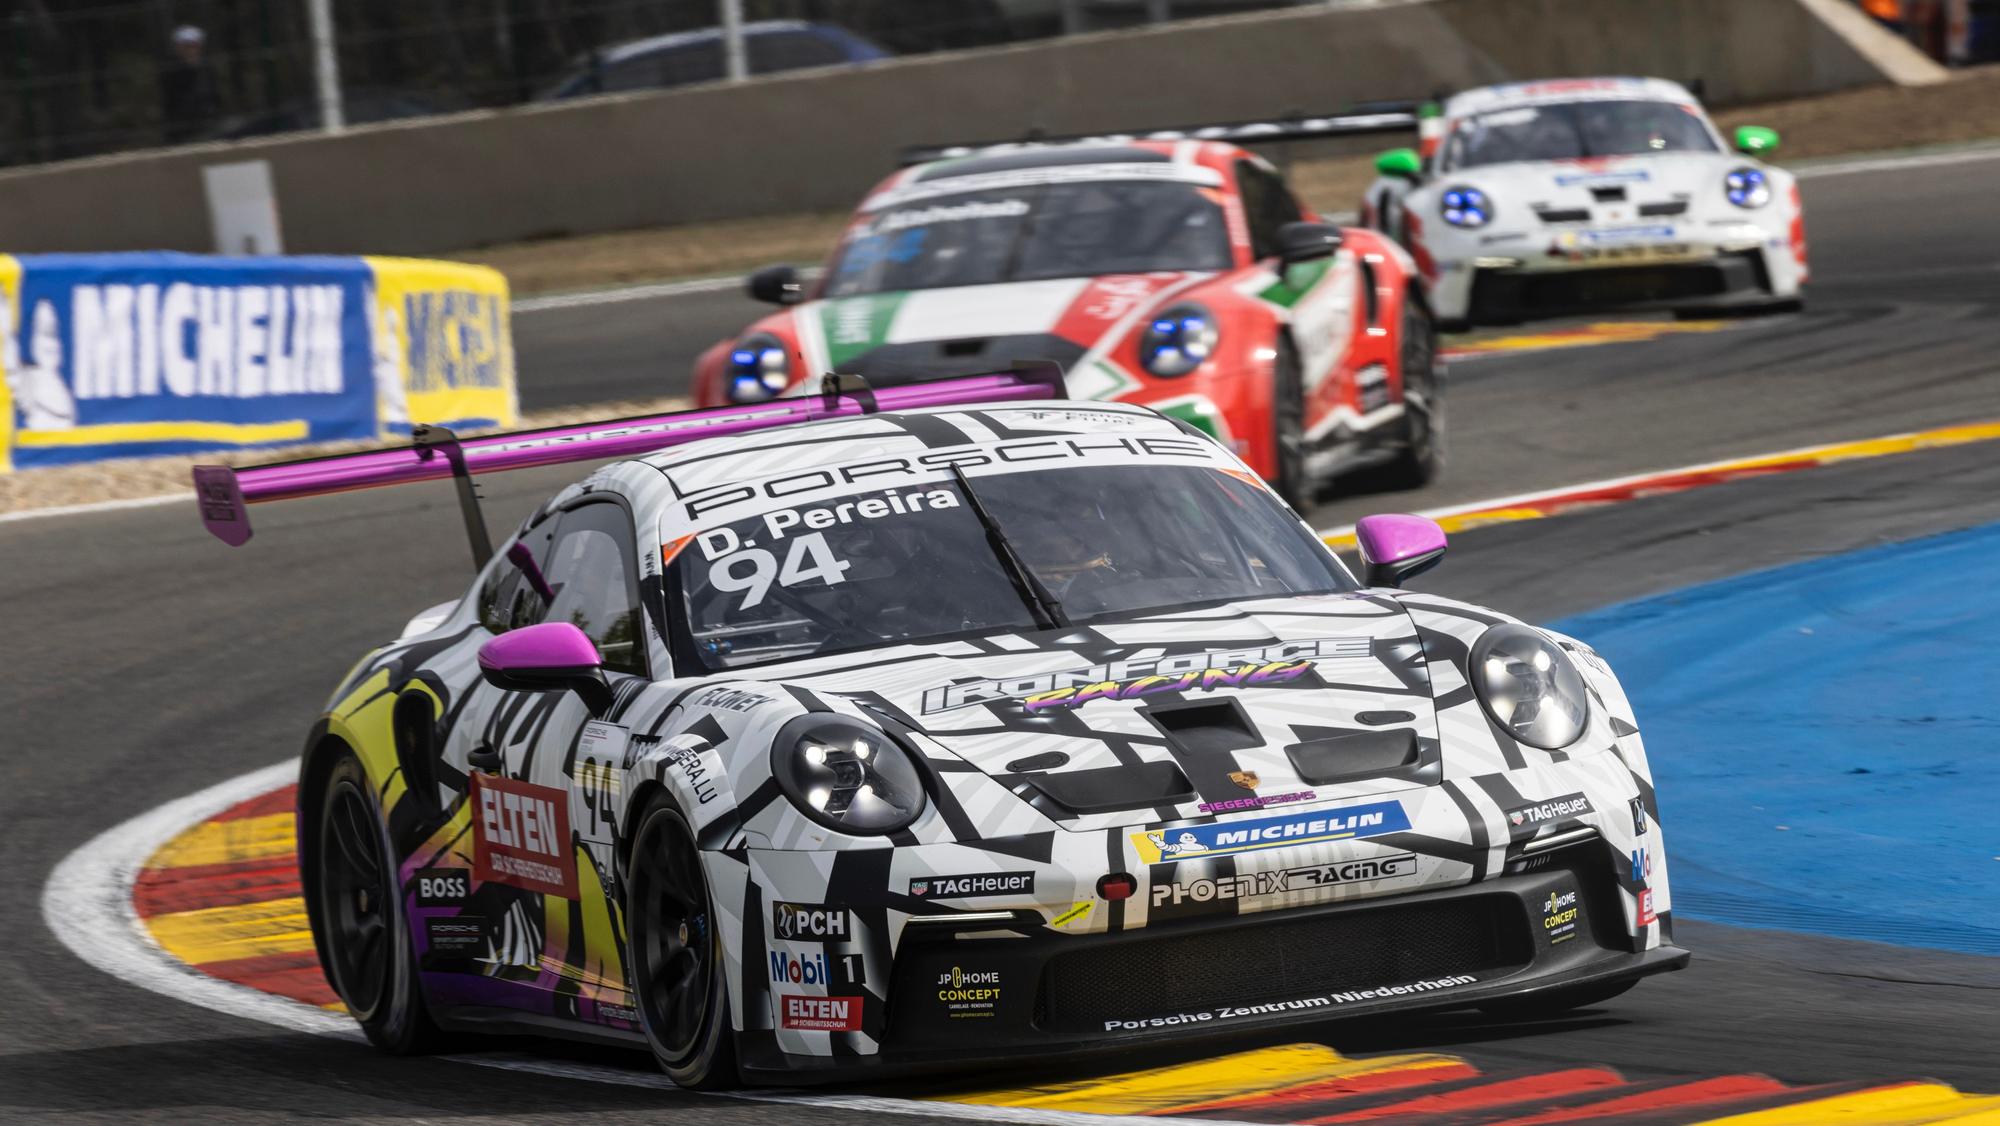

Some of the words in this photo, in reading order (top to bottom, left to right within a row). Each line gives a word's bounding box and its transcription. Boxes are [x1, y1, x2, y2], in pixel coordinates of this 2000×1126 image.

[72, 283, 344, 399] MICHELIN
[688, 438, 1213, 521] PORSCHE
[696, 528, 756, 562] D.
[763, 488, 960, 540] Pereira
[709, 532, 852, 612] 94
[921, 636, 1375, 716] IRONFORCE
[1022, 661, 1318, 716] RACING
[582, 756, 619, 838] 94
[1199, 790, 1317, 813] SIEGERDESIGNS
[480, 787, 560, 857] ELTEN
[1216, 812, 1383, 846] MICHELIN
[420, 878, 466, 898] BOSS
[1557, 892, 1576, 908] HOME
[796, 911, 845, 936] PCH
[1544, 908, 1577, 929] CONCEPT
[770, 951, 833, 985] Mobil
[842, 956, 855, 983] 1
[962, 972, 1000, 984] HOME
[788, 999, 849, 1019] ELTEN
[939, 988, 1001, 1001] CONCEPT
[1104, 1009, 1213, 1031] Porsche
[1215, 995, 1331, 1019] Zentrum
[1332, 972, 1478, 1004] Niederrhein
